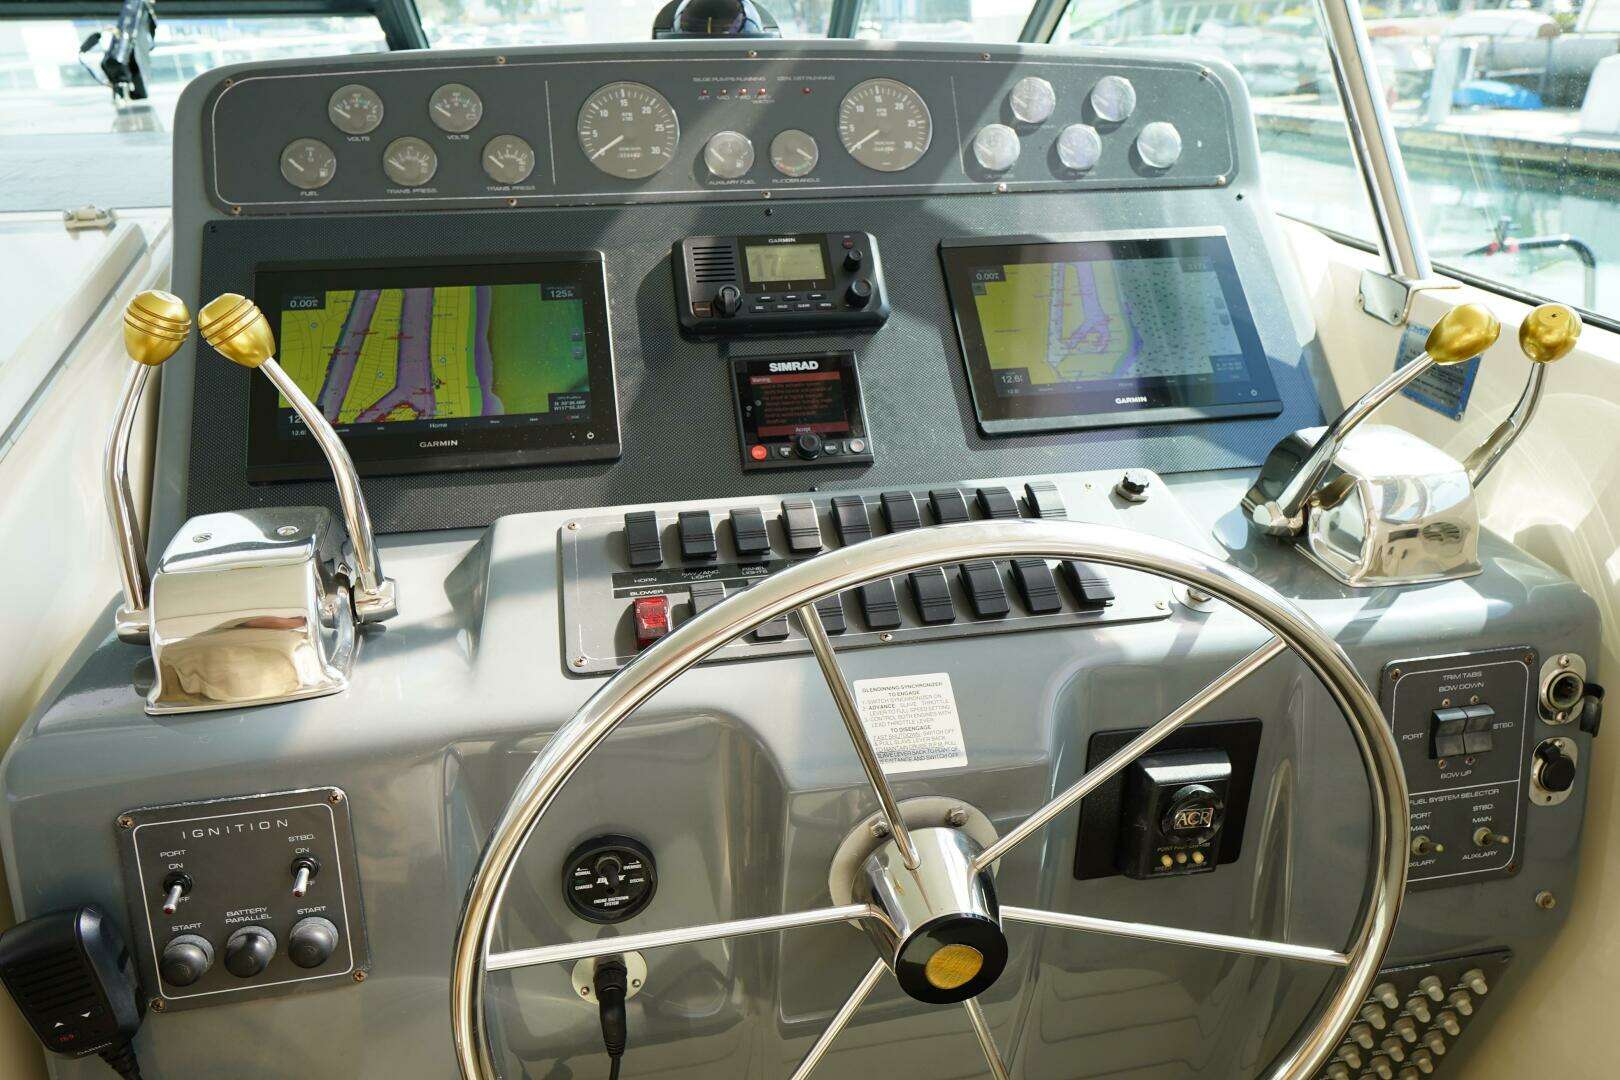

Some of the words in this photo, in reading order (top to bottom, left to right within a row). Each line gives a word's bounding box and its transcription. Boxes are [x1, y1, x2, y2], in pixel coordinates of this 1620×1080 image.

[620, 99, 629, 107] 15
[641, 106, 652, 115] 20
[855, 105, 864, 113] 10
[655, 123, 665, 132] 25
[907, 119, 917, 128] 25
[592, 130, 598, 138] 5
[651, 146, 661, 154] 30
[768, 237, 796, 245] GARMIN
[290, 299, 312, 309] 0.00
[769, 361, 819, 373] SIMRAD
[1115, 396, 1148, 405] GARMIN
[429, 422, 448, 430] Home
[419, 439, 459, 449] GARMIN
[629, 589, 664, 597] BLOWER
[1442, 673, 1463, 681] TRIM
[1463, 670, 1483, 679] TABS
[1438, 685, 1457, 693] BOW
[1458, 682, 1485, 691] DOWN
[1492, 721, 1514, 730] STBD
[1402, 732, 1425, 741] PORT
[1440, 772, 1459, 780] BOW
[1428, 793, 1460, 804] SYSTEM
[1460, 788, 1500, 799] SELECTOR
[1176, 811, 1209, 827] ACR
[1410, 811, 1432, 820] PORT
[1472, 815, 1492, 824] MAIN
[182, 818, 289, 840] IGNITION
[1410, 824, 1430, 832] MAIN
[288, 833, 316, 843] STBD.
[160, 849, 187, 858] PORT
[168, 862, 184, 870] ON
[226, 906, 268, 917] BATTERY
[297, 905, 327, 915] START
[225, 913, 272, 925] PARALLEL
[171, 922, 203, 932] START
